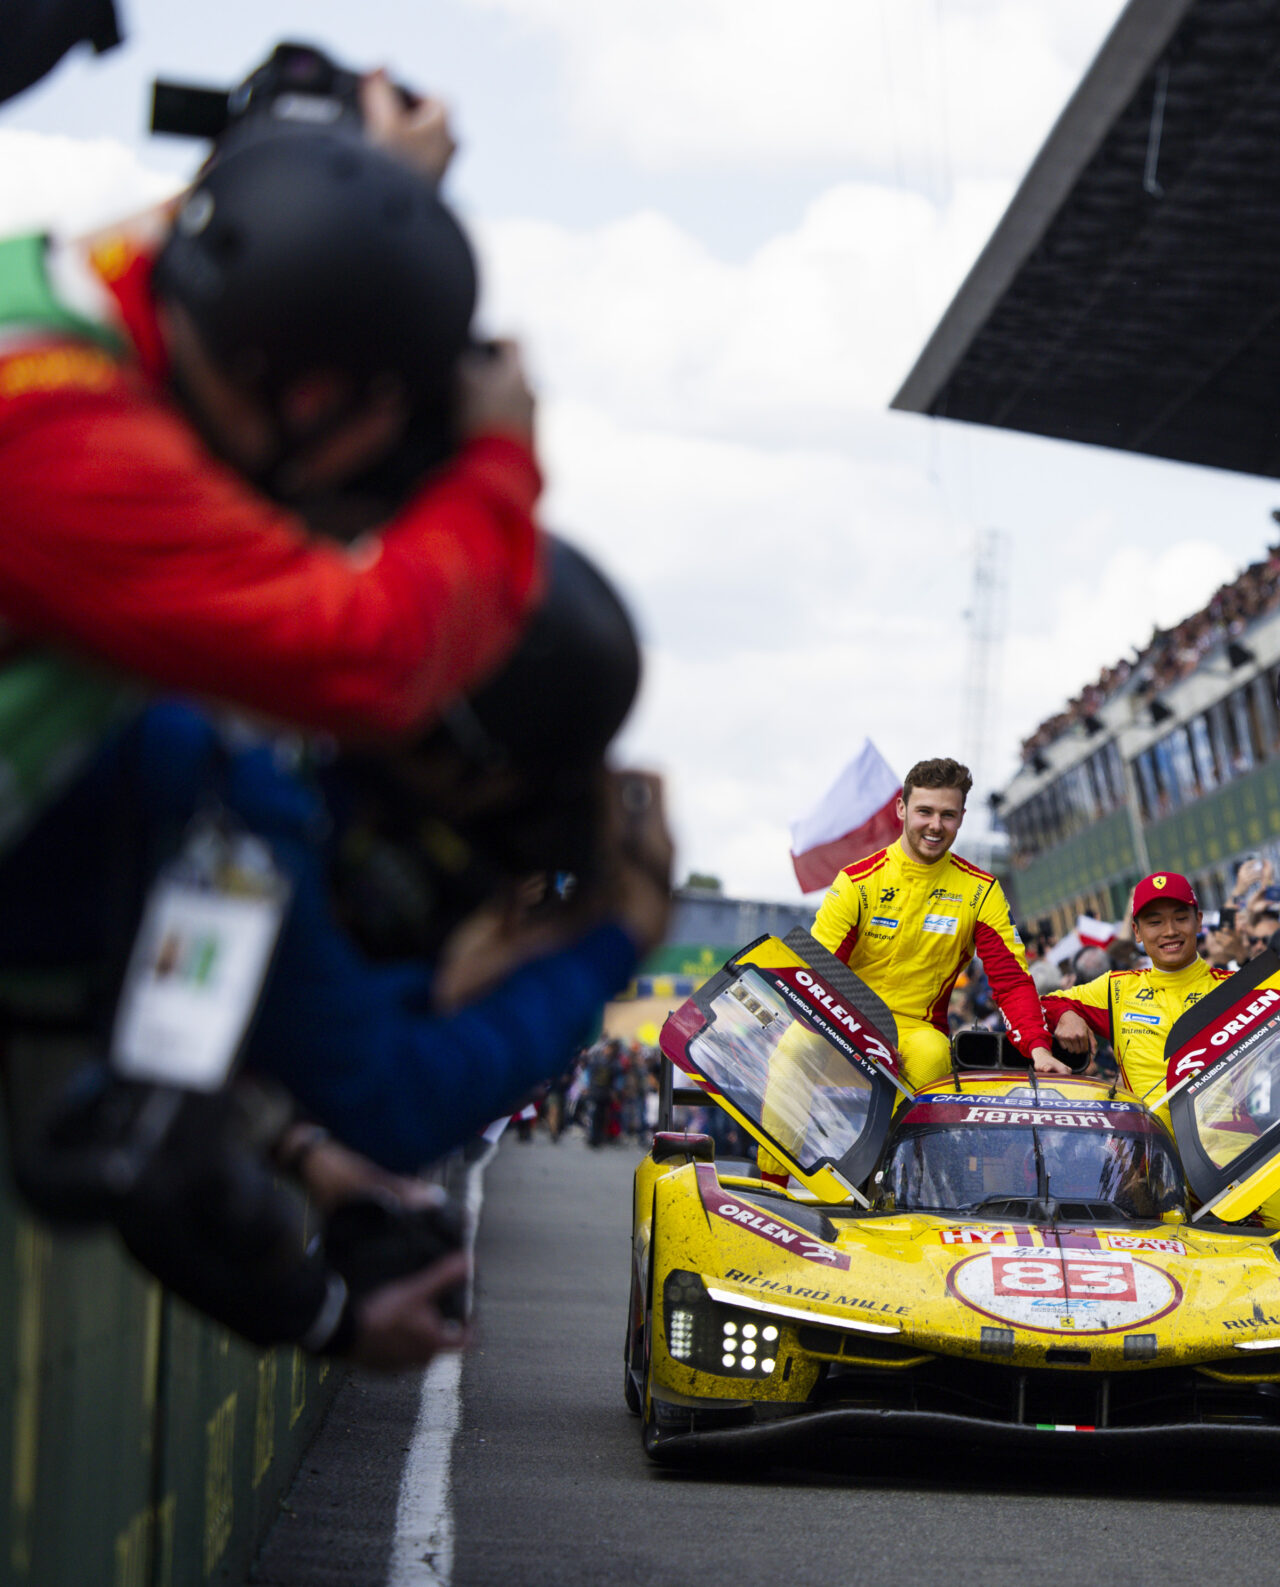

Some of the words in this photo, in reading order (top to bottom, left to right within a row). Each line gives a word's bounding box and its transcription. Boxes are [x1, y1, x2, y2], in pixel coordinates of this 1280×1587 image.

[795, 971, 862, 1033] ORLEN
[1210, 989, 1280, 1046] ORLEN
[789, 991, 813, 1017] KUBICA
[825, 1026, 854, 1055] HANSON
[866, 1062, 878, 1076] YE
[1200, 1060, 1228, 1082] KUBICA
[1240, 1026, 1269, 1052] HANSON
[931, 1094, 1033, 1107] CHARLES
[1039, 1100, 1104, 1109] POZZI
[960, 1106, 1116, 1129] Ferrari
[718, 1204, 799, 1244] ORLEN
[942, 1231, 1003, 1244] HY
[1113, 1239, 1181, 1254] CAR
[724, 1268, 831, 1301] RICHARD
[834, 1295, 914, 1317] MILLE
[1001, 1261, 1129, 1295] 83
[1031, 1300, 1101, 1309] WEC
